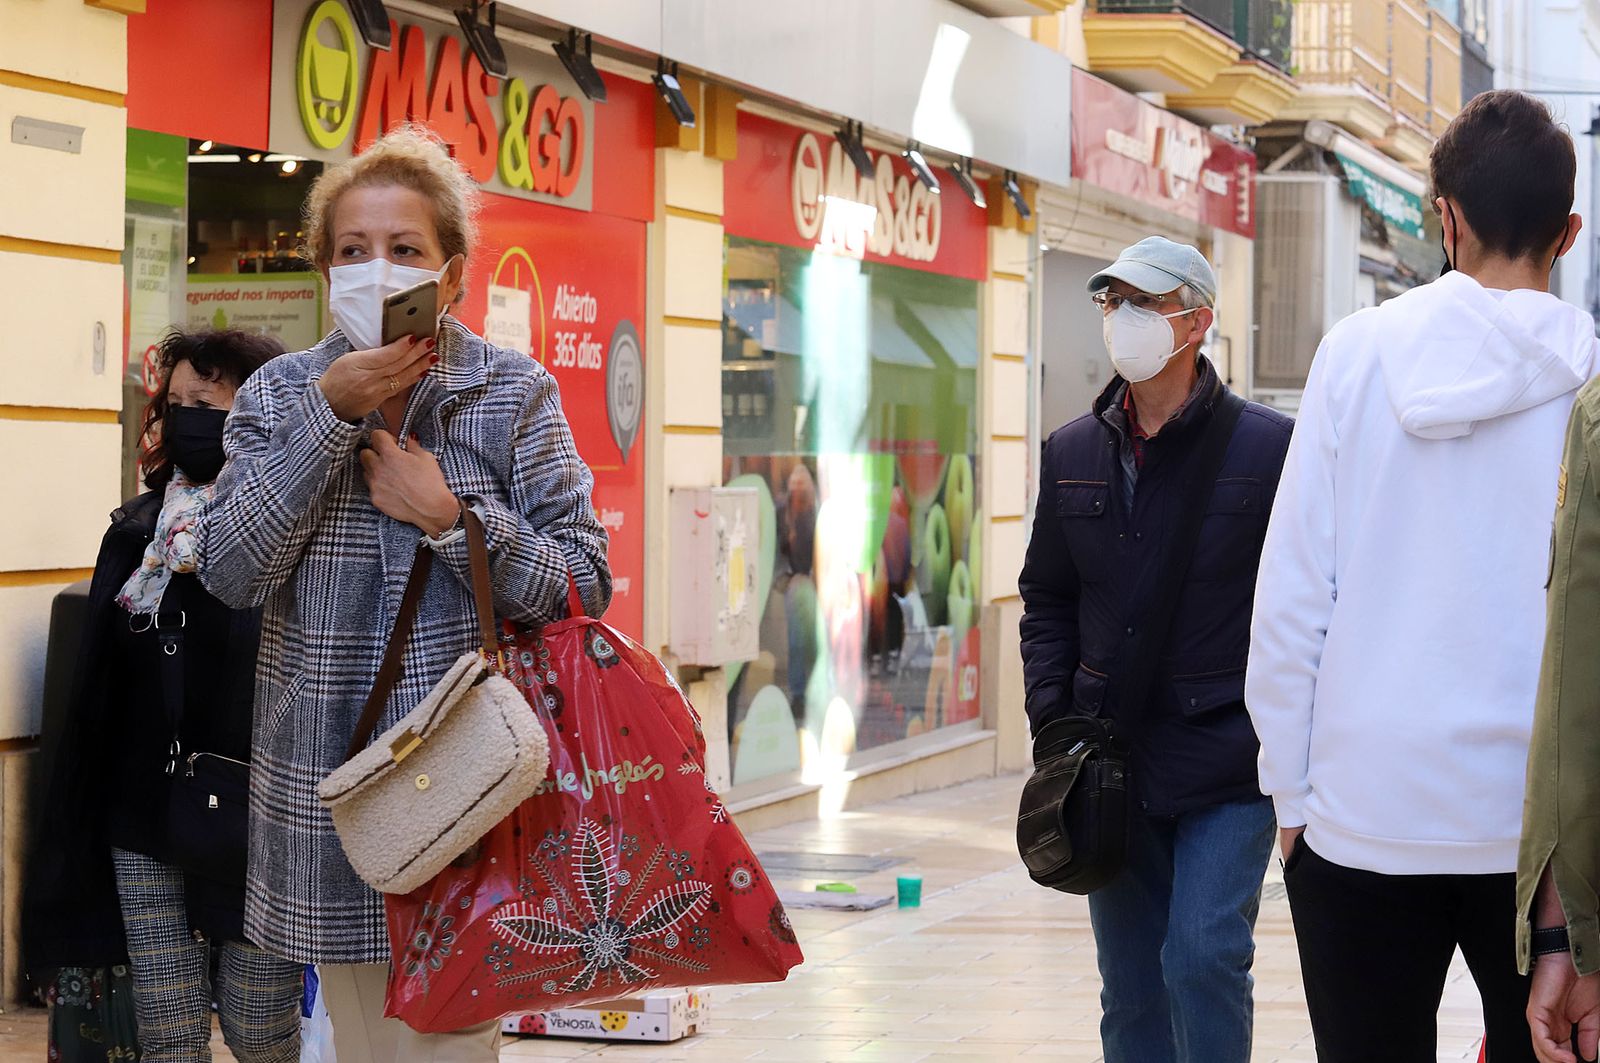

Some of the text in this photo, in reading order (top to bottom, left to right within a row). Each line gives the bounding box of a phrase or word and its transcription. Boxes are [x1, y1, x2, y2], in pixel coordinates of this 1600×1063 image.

[186, 287, 315, 305] eguridad nos importa
[552, 284, 597, 324] Abierto
[553, 332, 602, 370] 365 días
[581, 752, 665, 800] Inglés
[550, 1018, 596, 1030] VENOSTA
